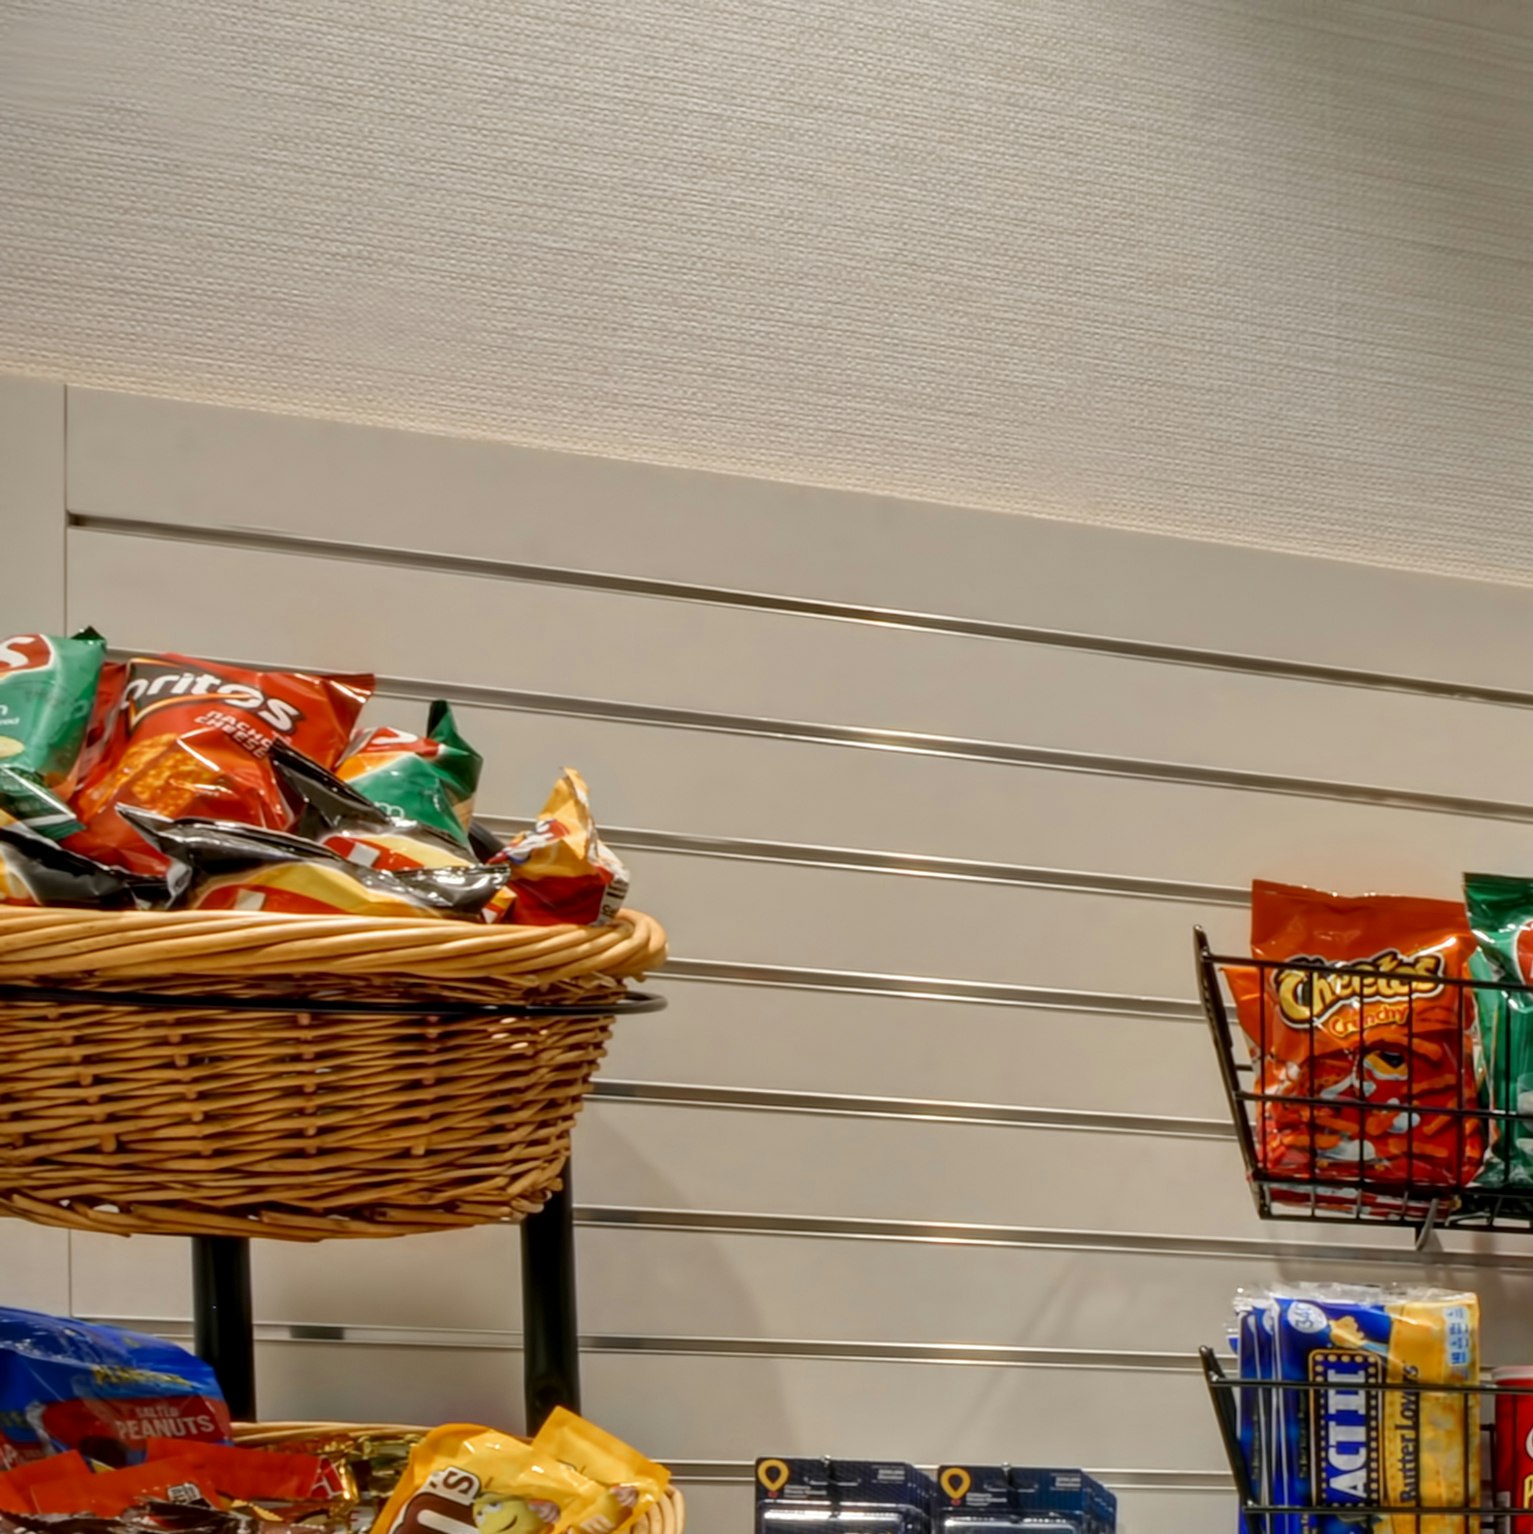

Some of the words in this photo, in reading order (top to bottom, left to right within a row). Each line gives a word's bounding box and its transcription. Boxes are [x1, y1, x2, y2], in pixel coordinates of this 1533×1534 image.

[119, 671, 300, 733] oritos
[1275, 948, 1446, 1024] Cheetos
[114, 1415, 215, 1441] PEANUTS
[1327, 1420, 1368, 1498] ACT
